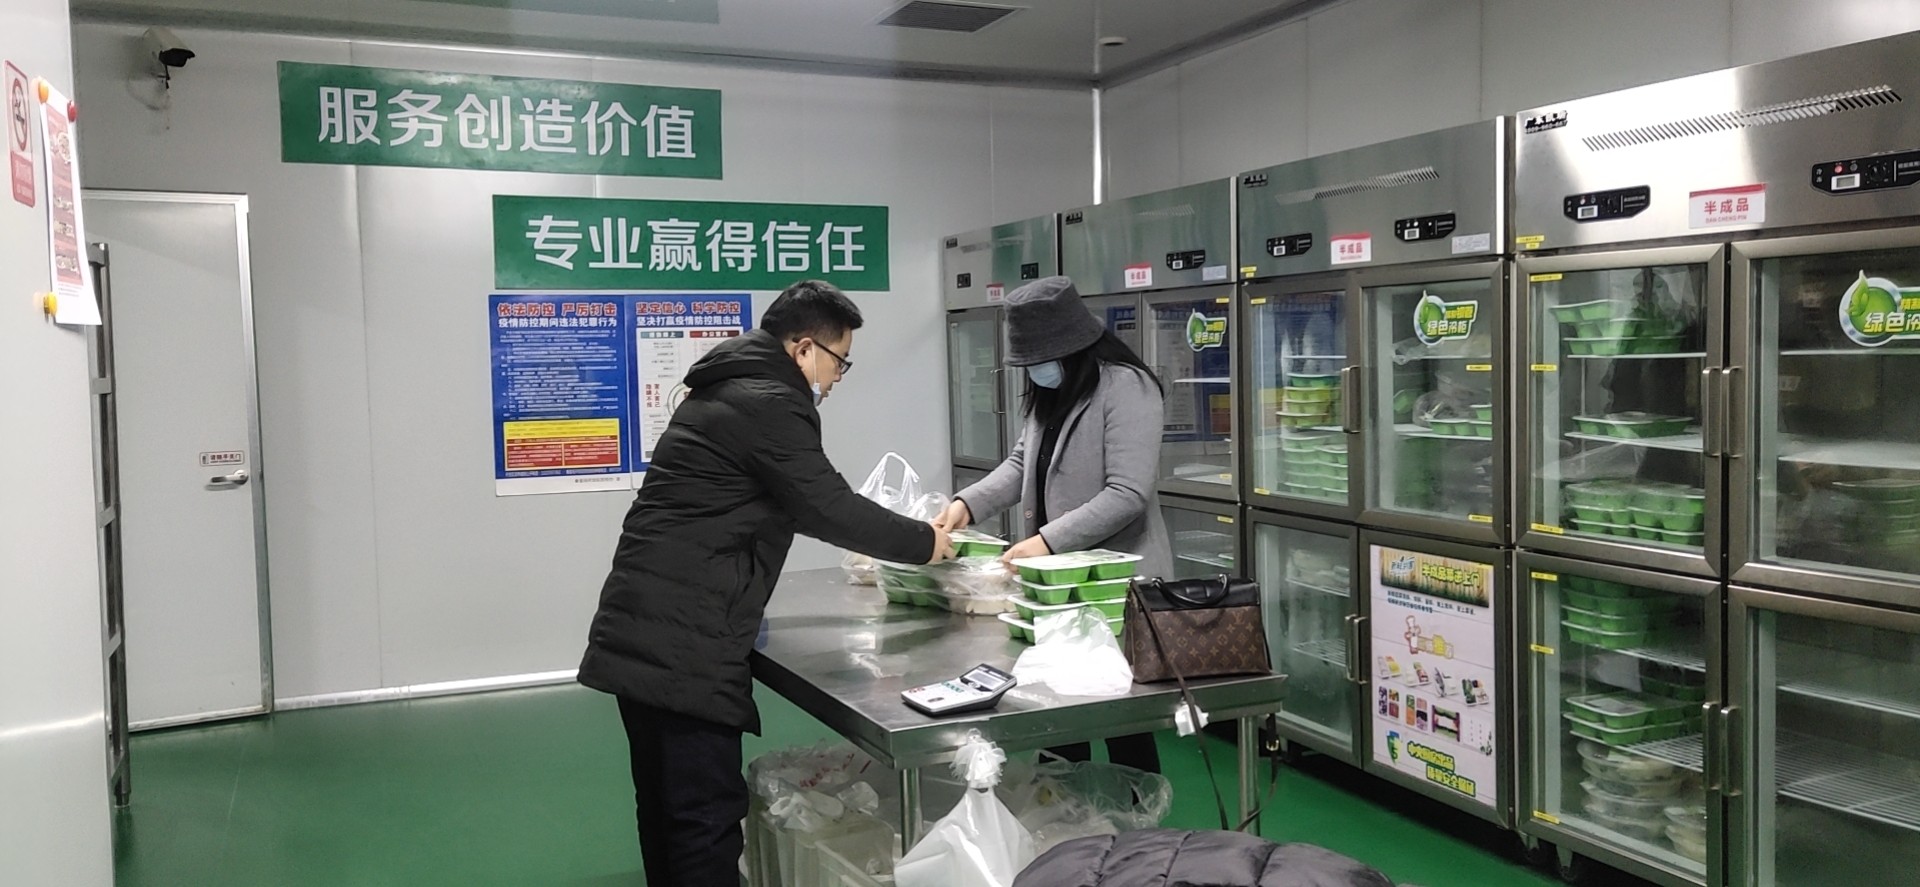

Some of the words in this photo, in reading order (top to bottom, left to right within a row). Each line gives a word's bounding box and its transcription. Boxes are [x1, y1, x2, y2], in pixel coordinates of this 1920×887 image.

[317, 86, 697, 159] 服务创造价值
[1704, 197, 1749, 215] 半成品
[525, 215, 866, 273] 专业赢得信任
[497, 302, 556, 317] 依法防控
[561, 302, 617, 316] 严厉打击
[636, 301, 687, 316] 坚定信心
[691, 301, 741, 315] 科学防控
[498, 317, 617, 328] 疫情防控期间违法犯罪行为
[636, 315, 742, 327] 坚决打赢疫情防控阻击战
[1427, 320, 1468, 336] 绿色冷柜
